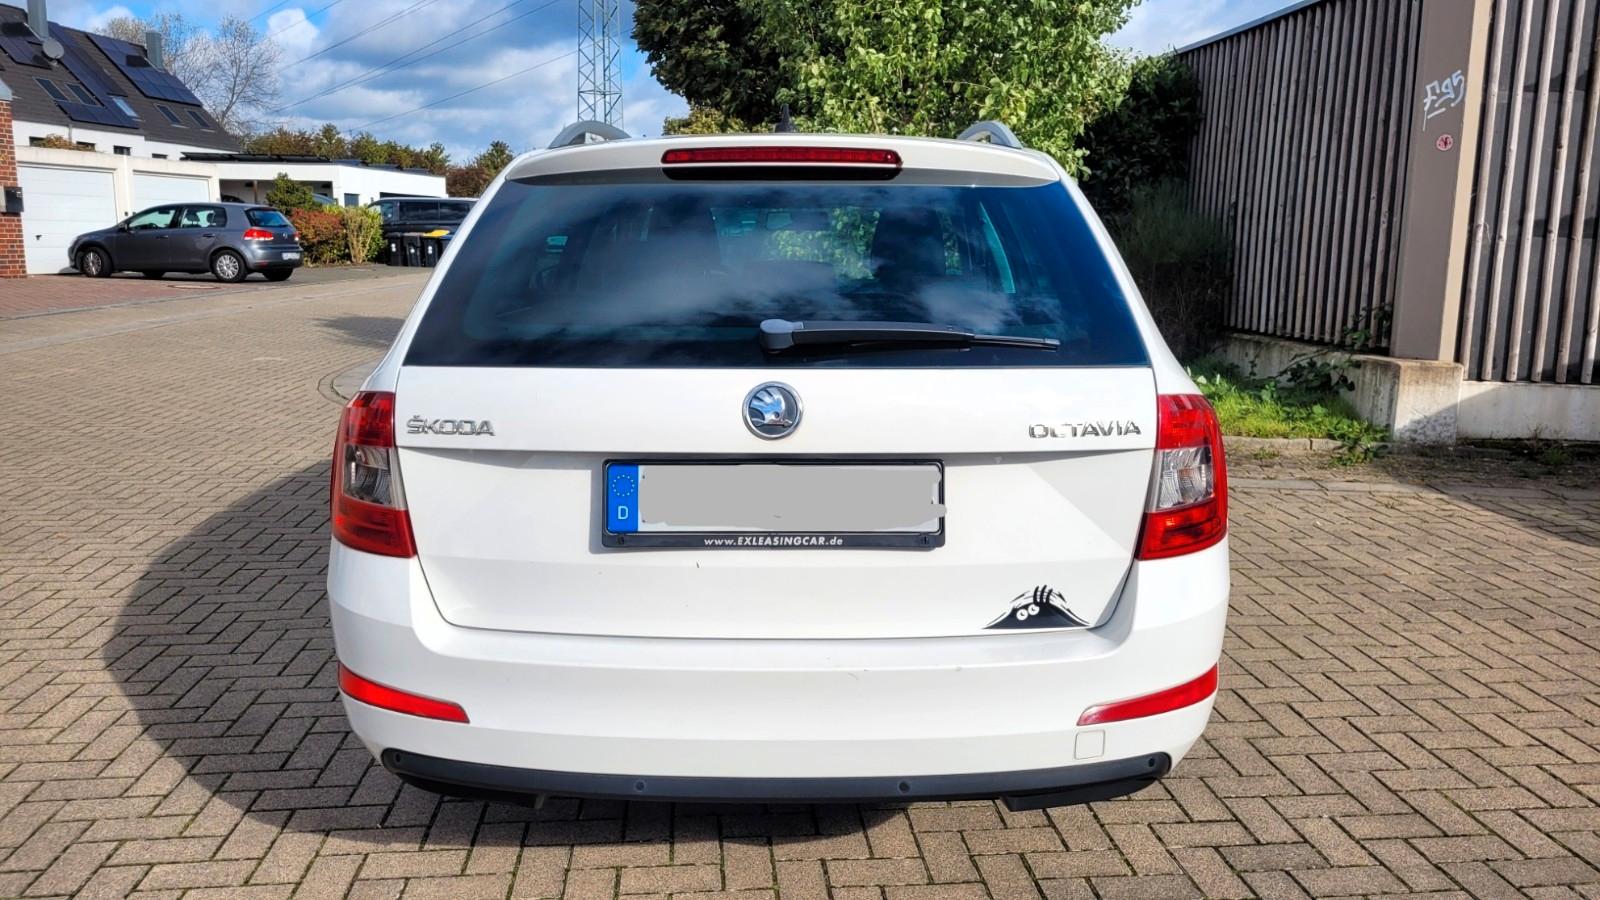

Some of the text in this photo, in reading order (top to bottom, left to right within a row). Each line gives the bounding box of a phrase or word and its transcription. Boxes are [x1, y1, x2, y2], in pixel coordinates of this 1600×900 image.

[406, 415, 496, 436] ŠKODA
[1028, 420, 1142, 439] OCTAVIA
[617, 505, 629, 520] D
[704, 536, 844, 546] www.EXLEASINGCAR.de
